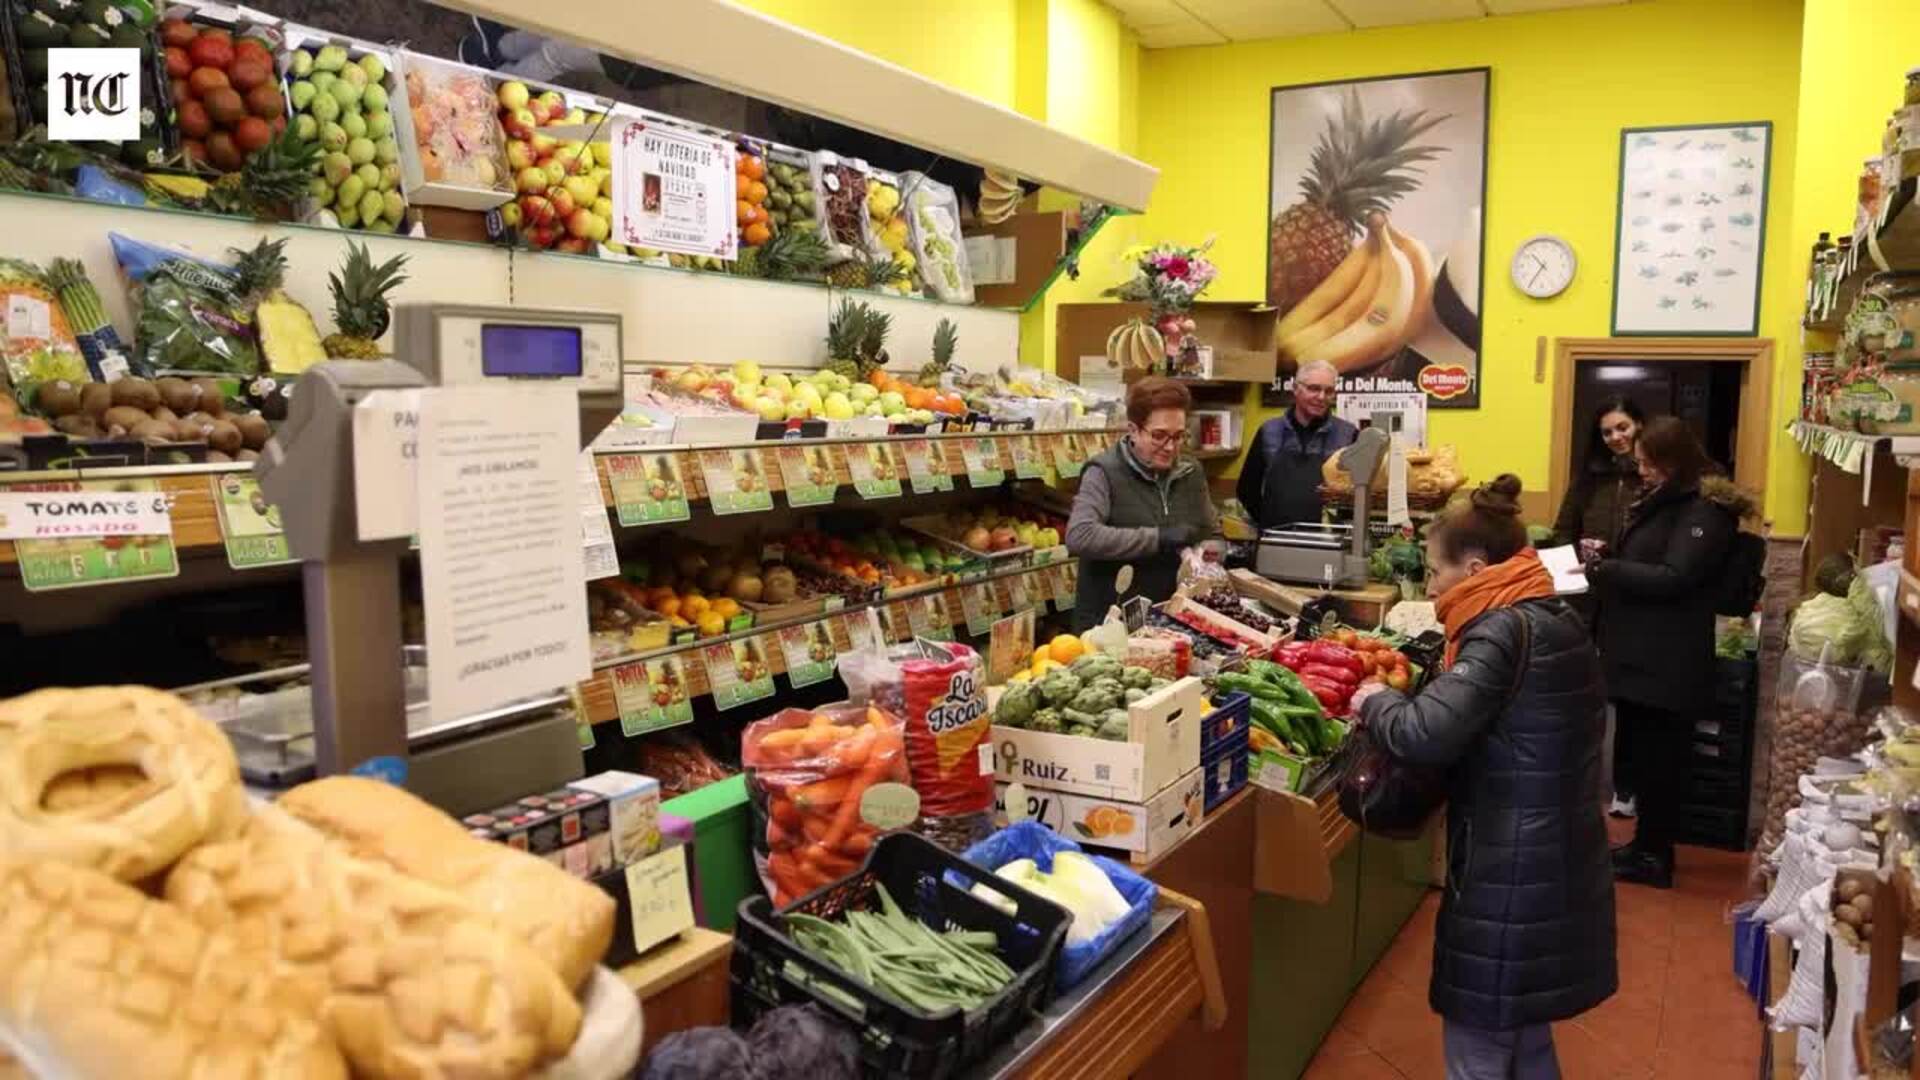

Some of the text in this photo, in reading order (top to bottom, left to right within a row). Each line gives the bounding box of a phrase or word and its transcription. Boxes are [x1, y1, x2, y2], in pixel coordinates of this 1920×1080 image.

[658, 159, 697, 180] NAVIDAD
[1355, 376, 1375, 391] Del
[1377, 377, 1417, 391] Monte.
[25, 501, 139, 516] TOMATE
[36, 522, 138, 534] ROSADO
[946, 675, 975, 703] La
